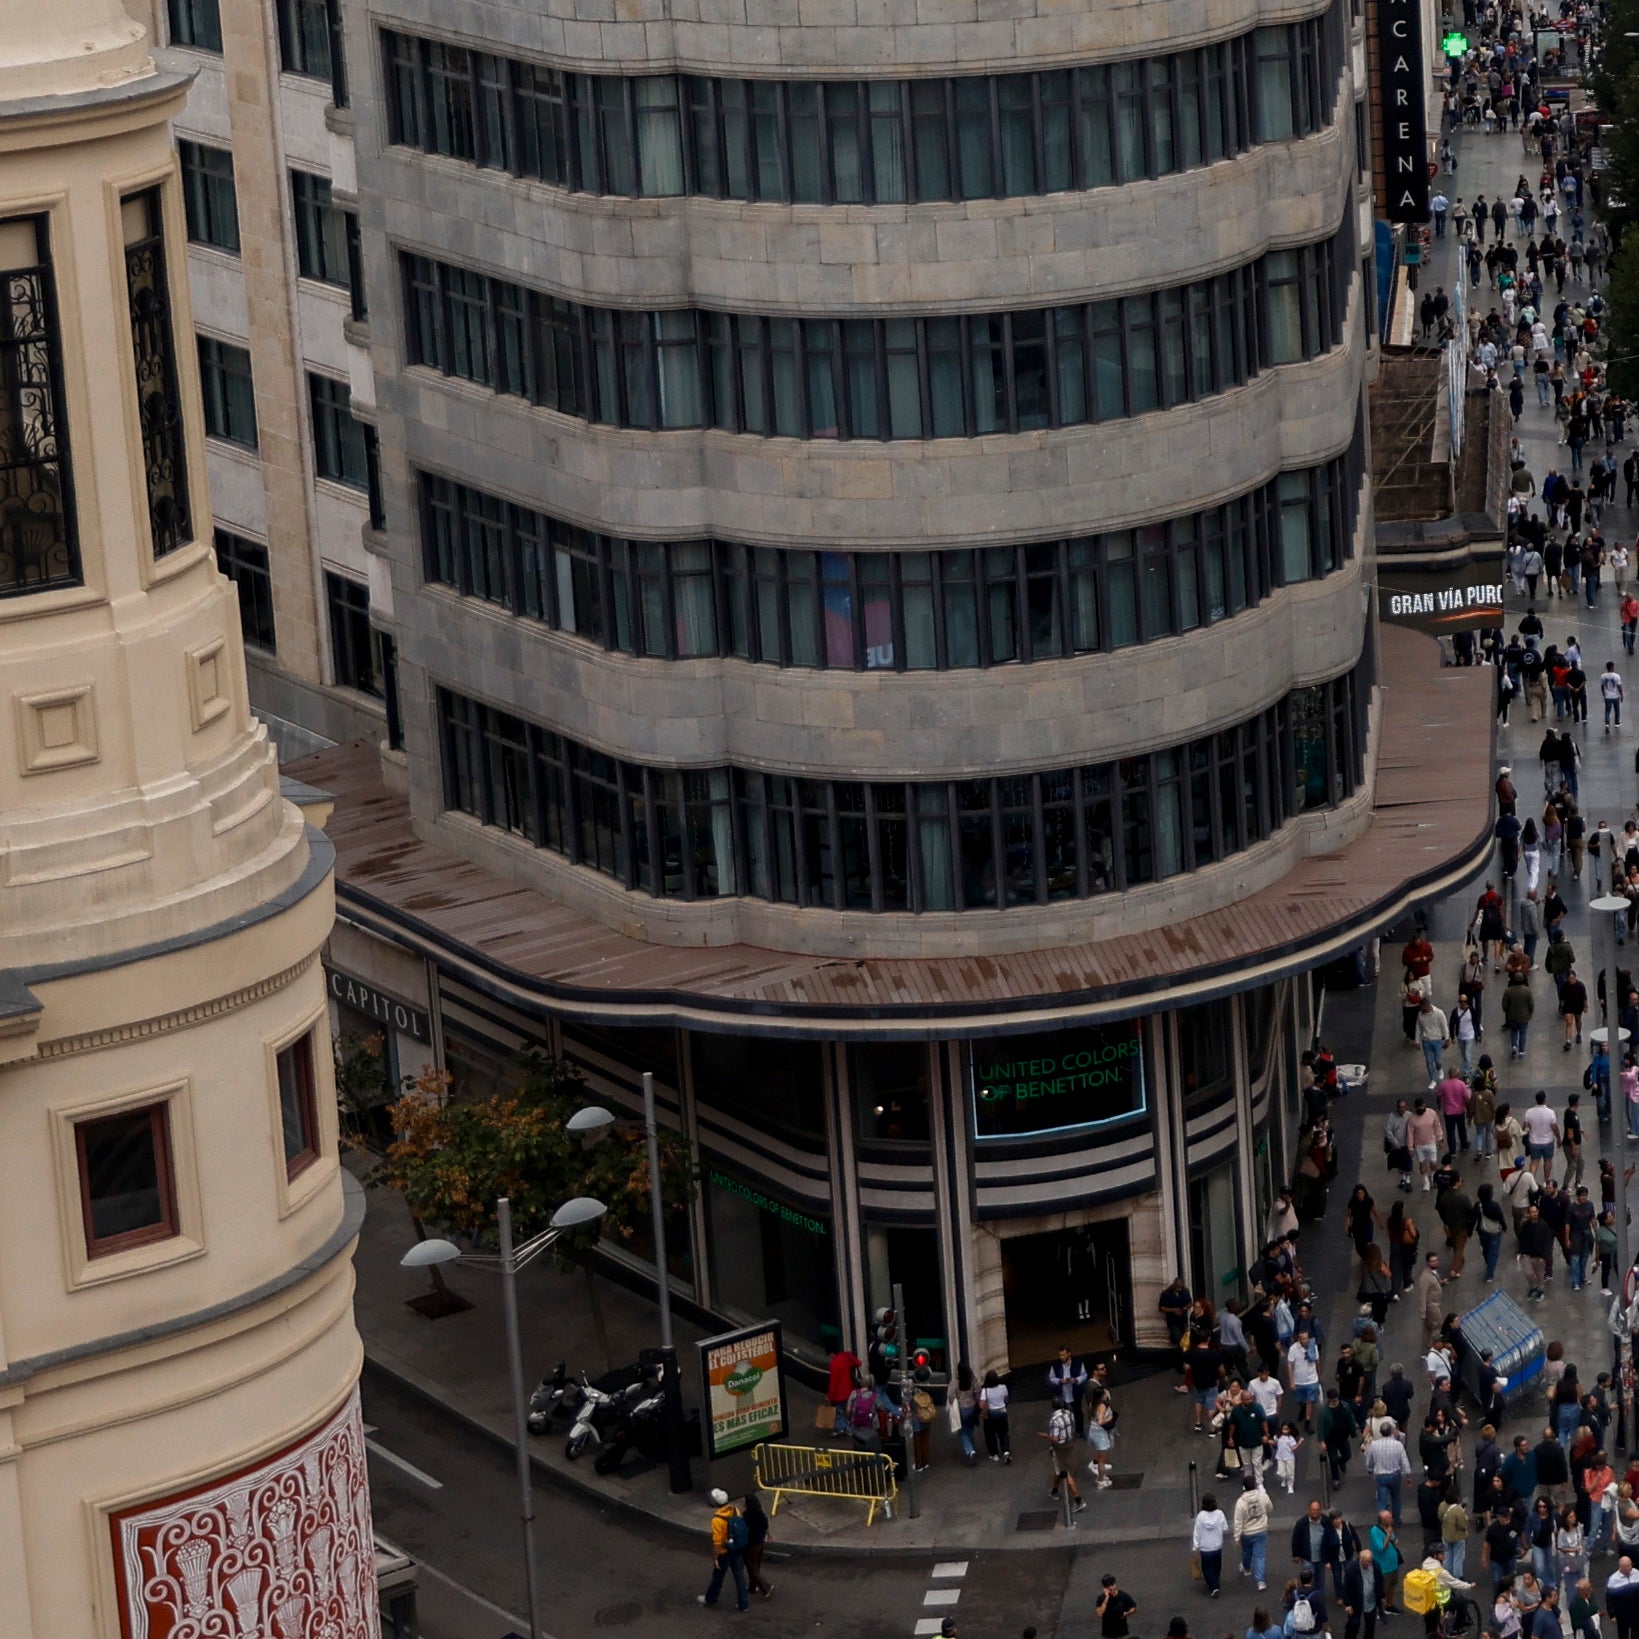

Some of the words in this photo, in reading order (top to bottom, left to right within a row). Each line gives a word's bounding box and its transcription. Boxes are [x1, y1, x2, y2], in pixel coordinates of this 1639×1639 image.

[1391, 592, 1435, 615] GRAN
[331, 973, 420, 1037] CAPITOL
[978, 1058, 1056, 1081] UNITED
[1062, 1039, 1139, 1071] COLORS
[980, 1084, 1011, 1102] OF
[710, 1169, 738, 1193] UNITED
[738, 1184, 769, 1209] COLORS
[768, 1200, 779, 1213] OF
[708, 1342, 733, 1360] PARA
[734, 1331, 774, 1350] REDUCIR
[709, 1356, 721, 1370] EL
[721, 1341, 774, 1365] COLESTEROL
[728, 1372, 760, 1388] Danacol
[714, 1421, 725, 1433] ES
[749, 1404, 779, 1422] EFICAZ
